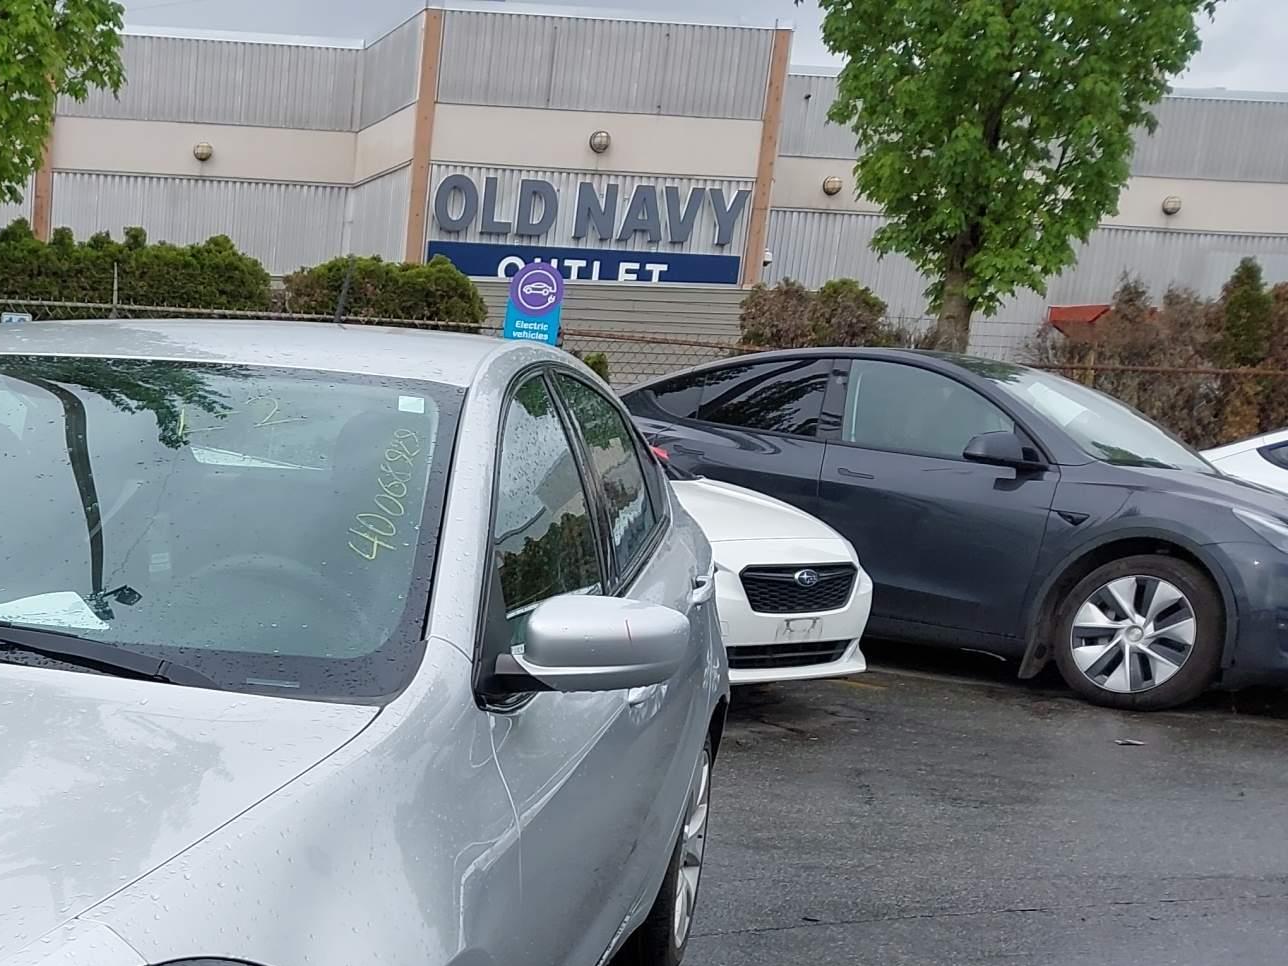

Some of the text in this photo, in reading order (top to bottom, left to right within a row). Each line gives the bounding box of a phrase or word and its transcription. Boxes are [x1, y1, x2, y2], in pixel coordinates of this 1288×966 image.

[433, 173, 753, 246] OLD NAVY
[515, 320, 549, 331] Electric
[512, 330, 549, 341] vehicles
